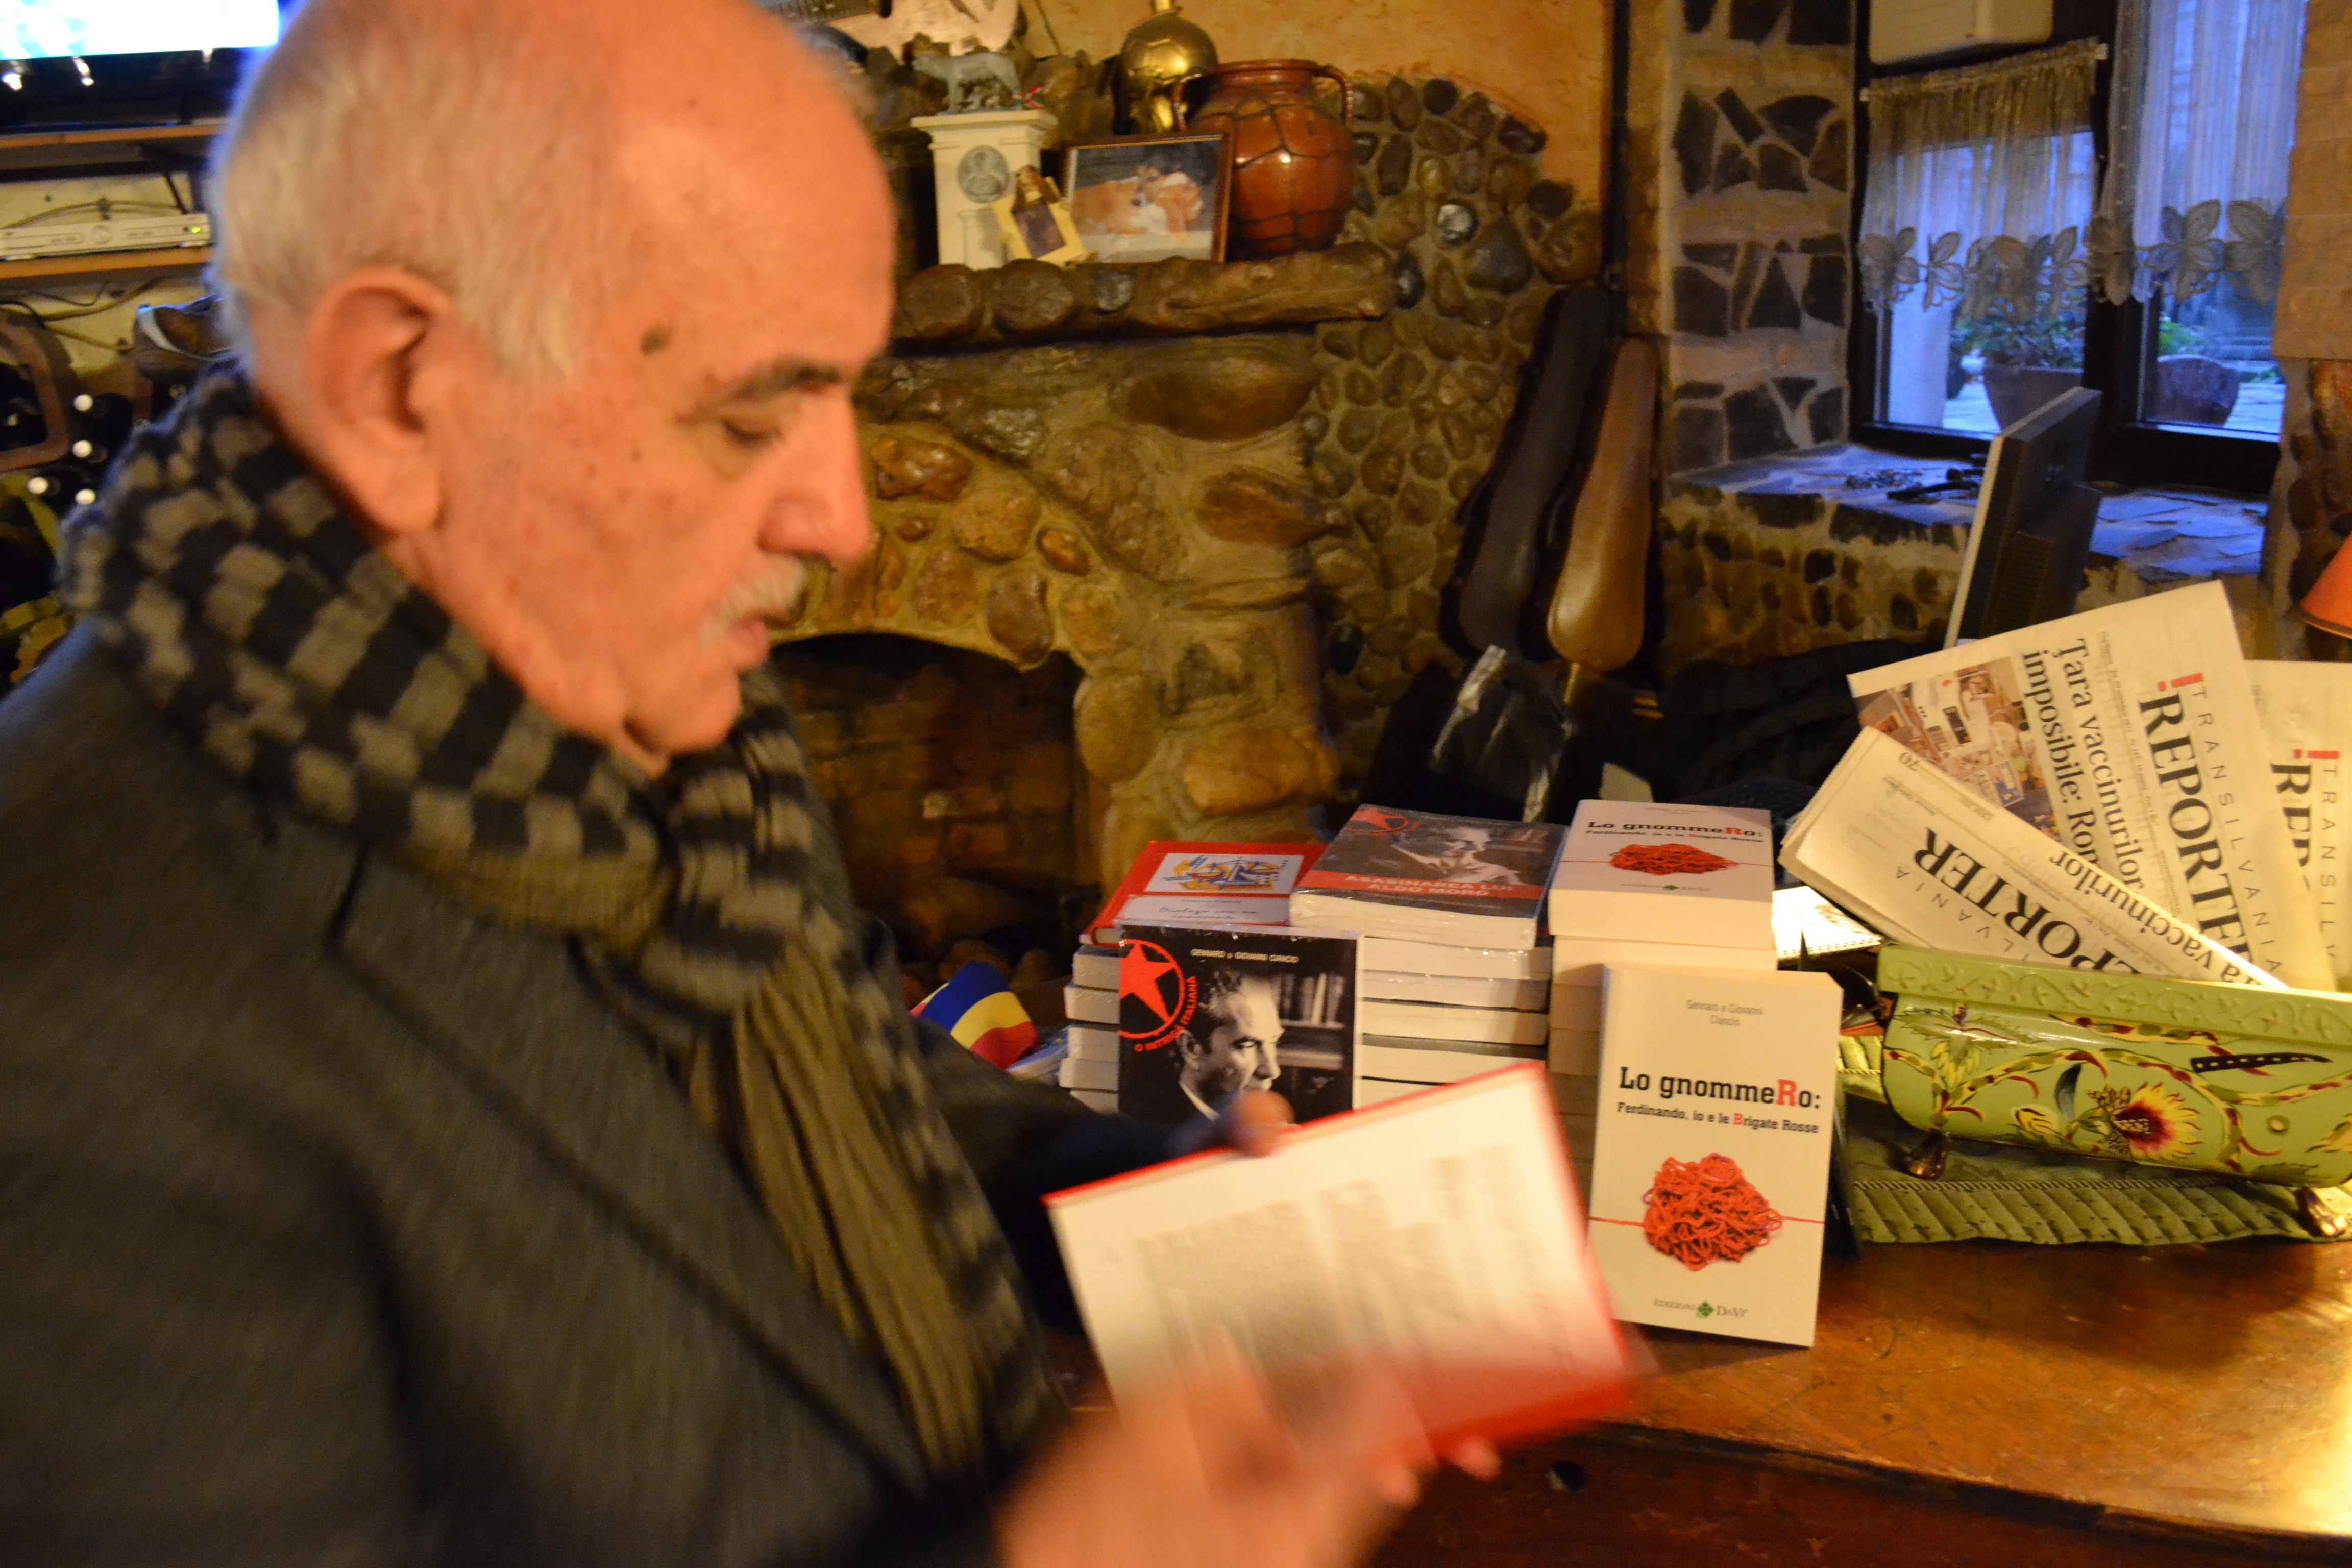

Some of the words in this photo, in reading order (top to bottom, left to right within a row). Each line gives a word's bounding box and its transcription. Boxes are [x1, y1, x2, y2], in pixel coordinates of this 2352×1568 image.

[2022, 650, 2085, 803] imposibile:
[1623, 823, 1763, 837] gnommeRo:
[2078, 714, 2144, 889] vaccinurilor
[2192, 687, 2282, 971] TRANSILVANIA
[1368, 884, 1423, 892] ALDO
[1429, 887, 1489, 896] MORO
[1896, 866, 2030, 962] ILVANIA
[1914, 827, 2141, 974] PORTER
[2050, 850, 2213, 969] vaccinurilor
[2319, 765, 2338, 959] TRANSILV
[1617, 1101, 1689, 1120] Ferdinando,
[1693, 1110, 1704, 1121] io
[1708, 1114, 1715, 1122] e
[1719, 1112, 1730, 1124] le
[1733, 1113, 1778, 1130] Brigate
[1782, 1119, 1819, 1134] Rosse
[1619, 1066, 1650, 1091] Lo
[1659, 1075, 1821, 1109] gnommeRo:
